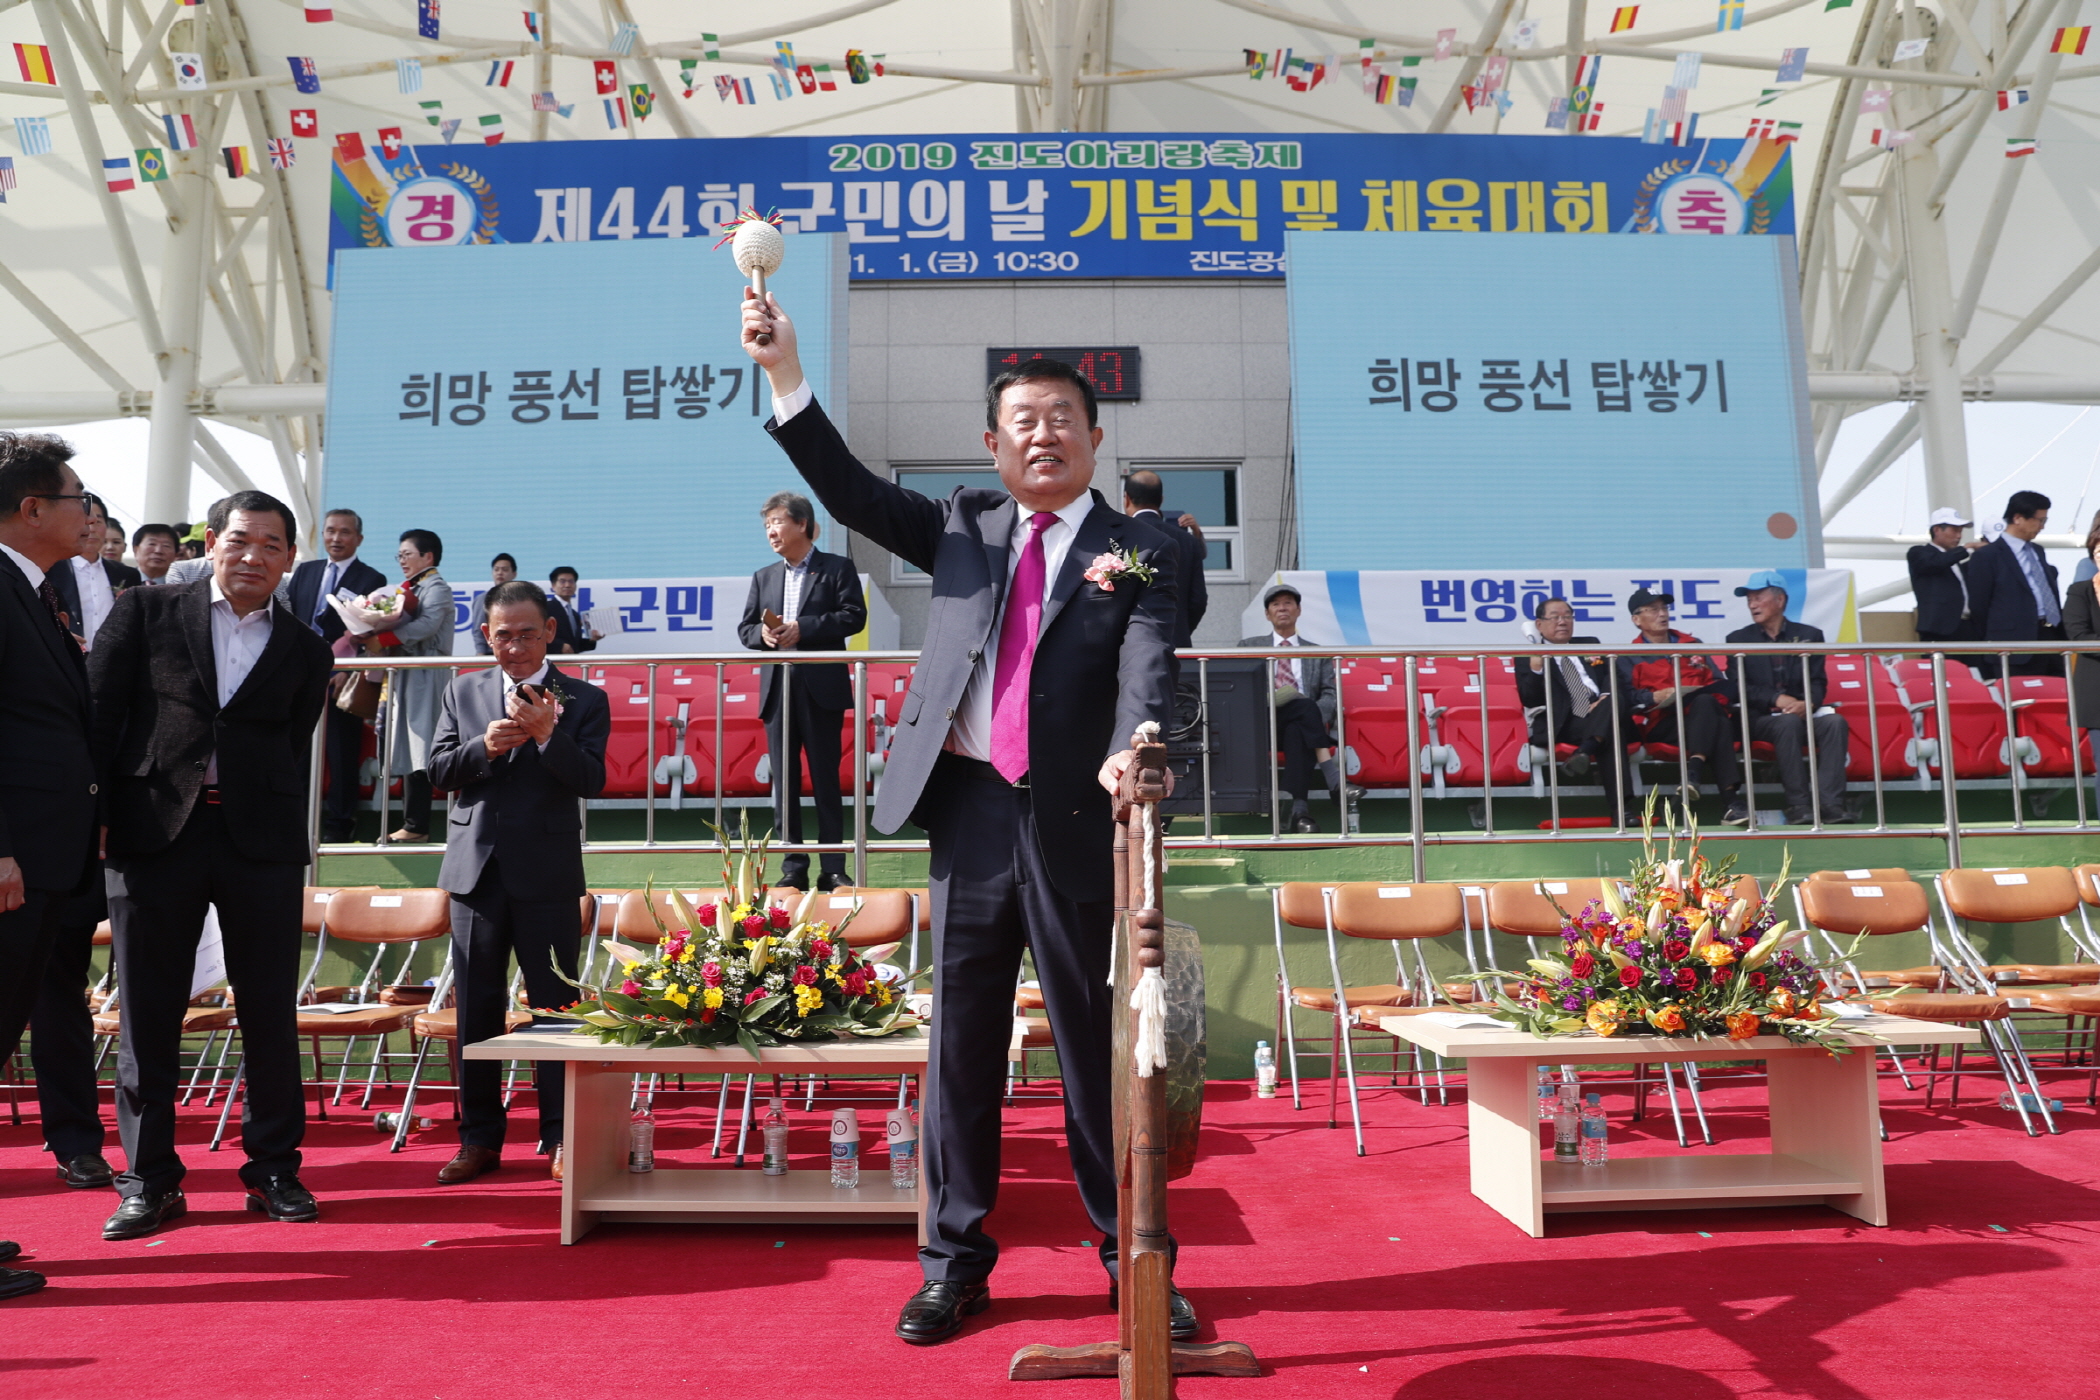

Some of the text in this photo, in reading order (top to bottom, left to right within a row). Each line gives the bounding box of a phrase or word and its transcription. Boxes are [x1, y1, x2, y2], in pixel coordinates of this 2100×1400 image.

[829, 140, 1302, 172] 2019 진도아리랑축제
[405, 194, 455, 242] 경
[778, 179, 965, 243] 군민의
[989, 179, 1049, 241] 날
[1070, 179, 1258, 242] 기념식
[1361, 178, 1609, 234] 체육대회
[1677, 190, 1727, 234] 축
[993, 251, 1080, 273] 10:30
[399, 363, 760, 426] 희망 풍선 탑쌓기
[1367, 357, 1729, 413] 희망 풍선 탑쌓기
[613, 586, 714, 632] 군민
[1421, 578, 1616, 623] 번영하는
